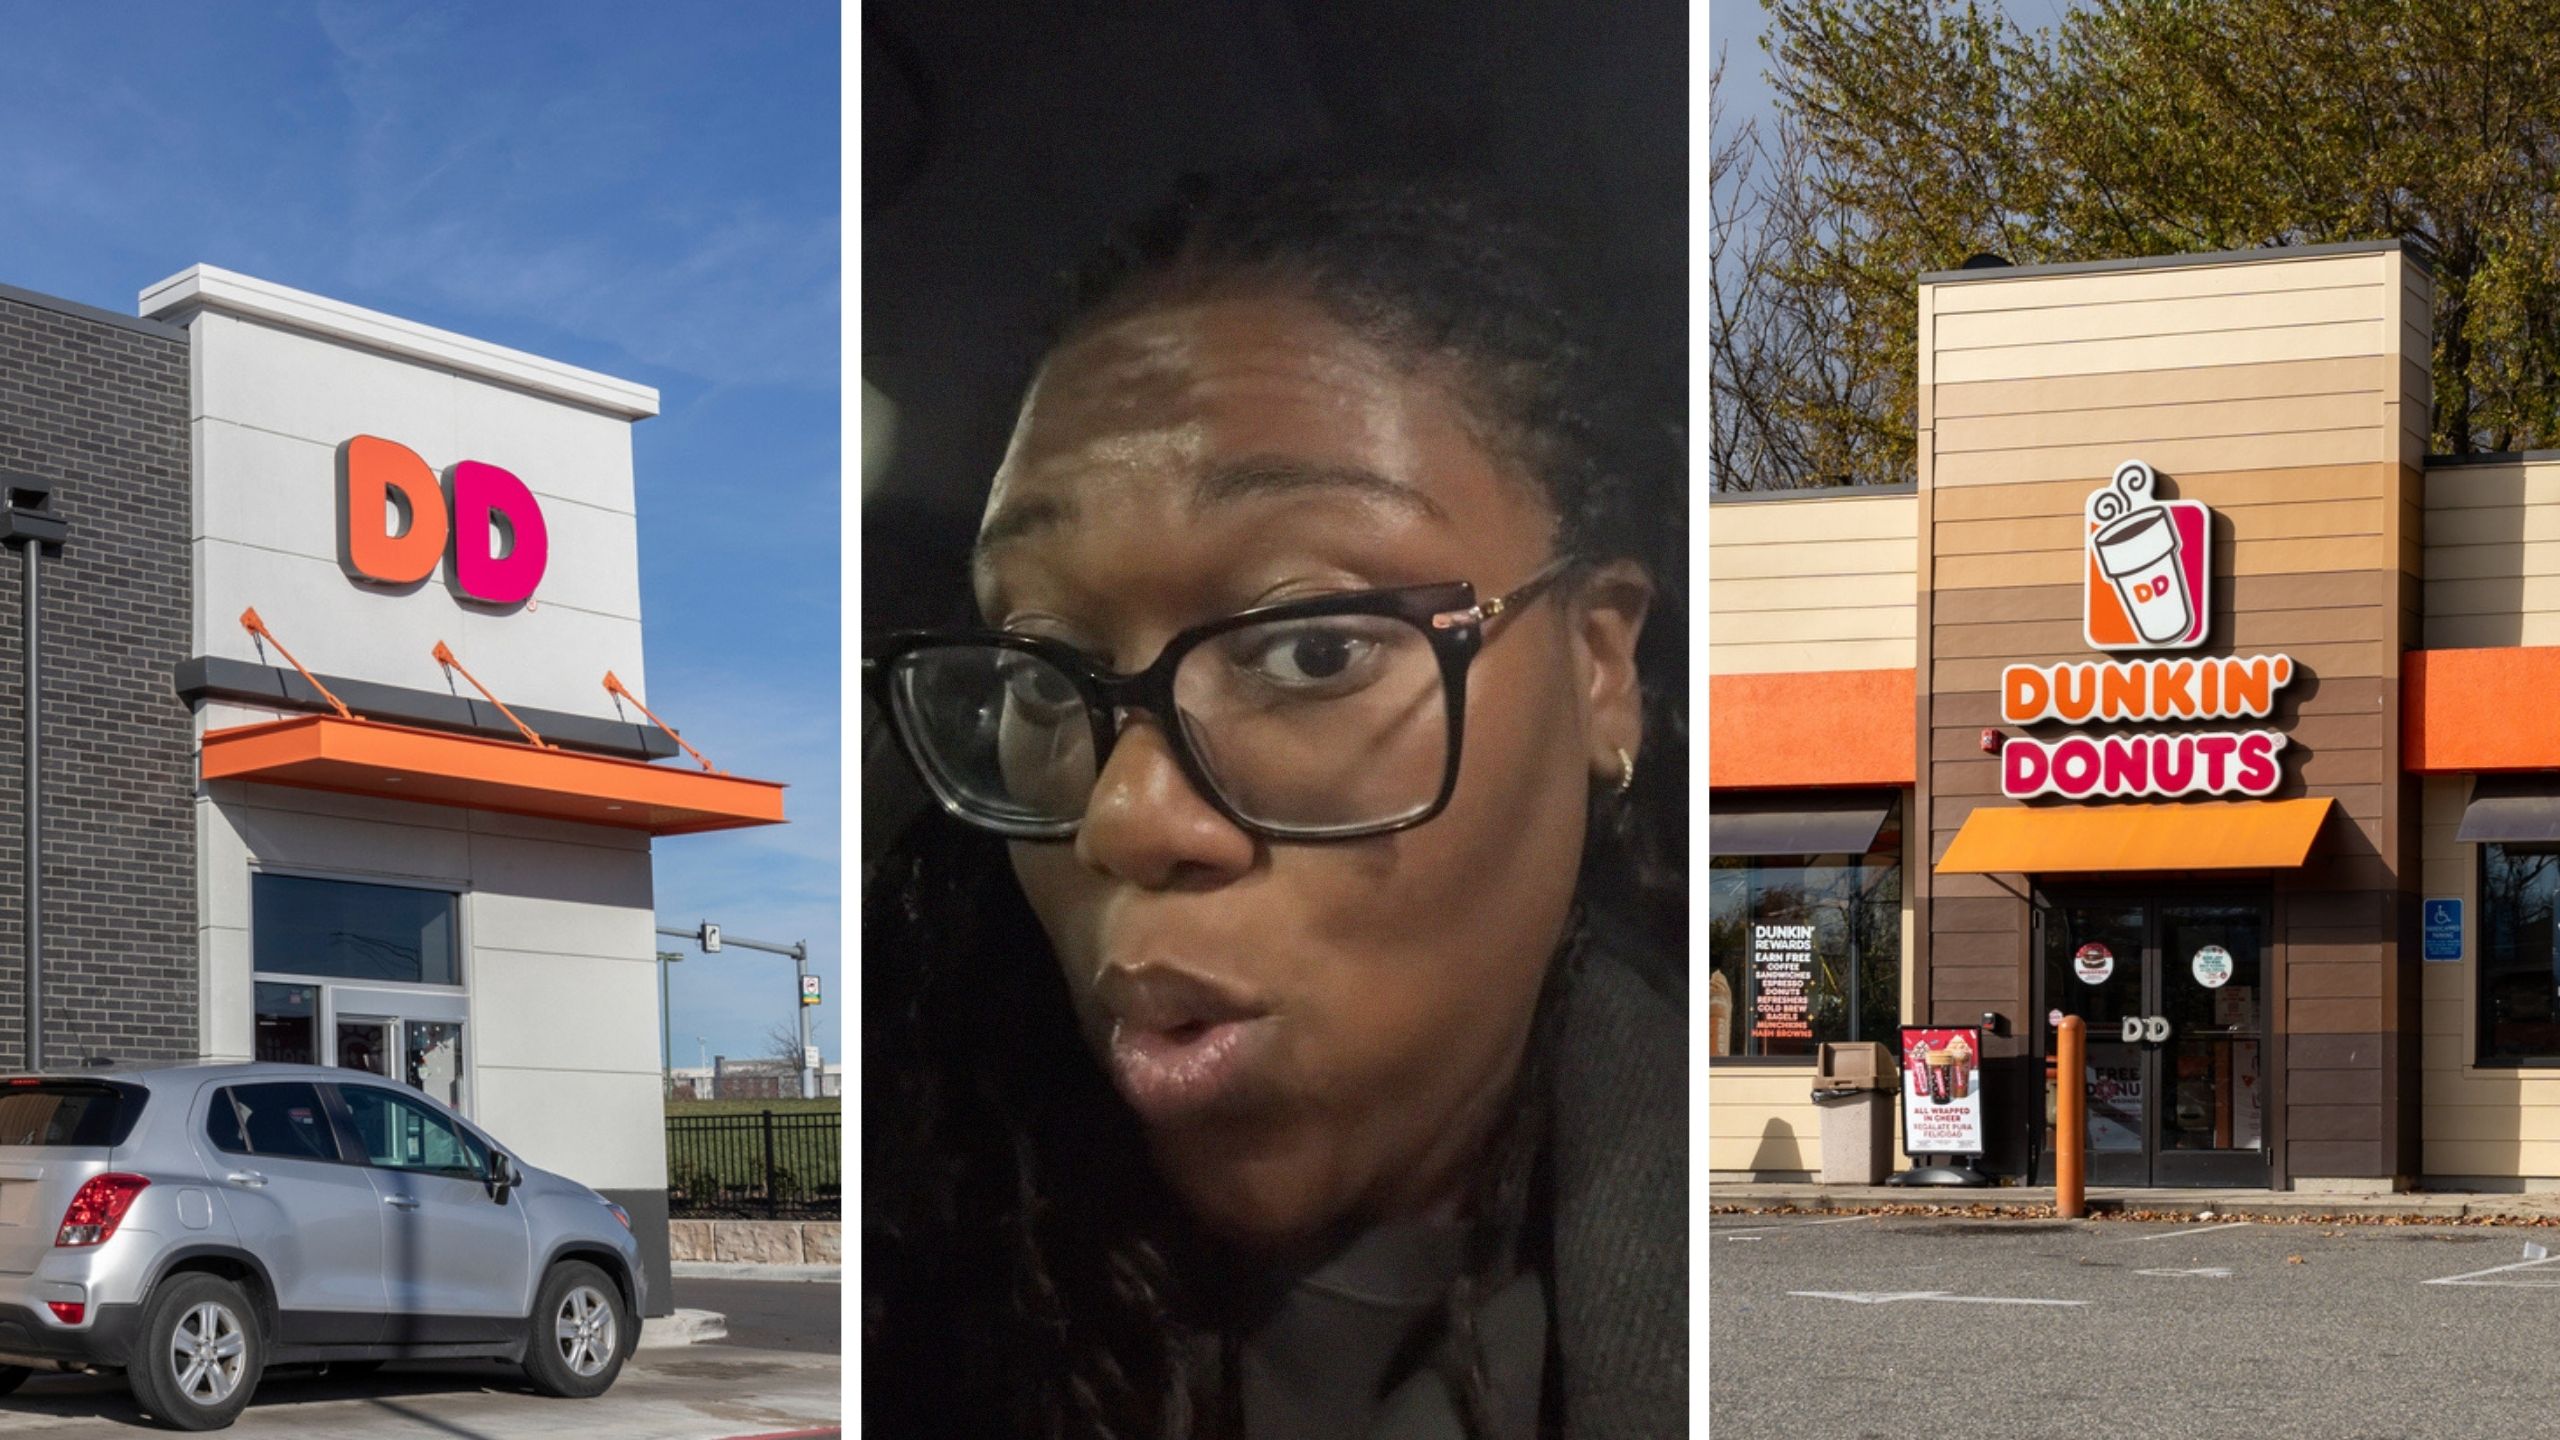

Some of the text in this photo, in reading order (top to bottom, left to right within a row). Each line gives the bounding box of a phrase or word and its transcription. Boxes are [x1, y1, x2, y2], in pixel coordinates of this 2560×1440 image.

[336, 434, 549, 603] DD
[2133, 574, 2169, 603] DD
[2004, 657, 2291, 722] DUNKIN'
[2004, 734, 2276, 795] DONUTS
[1755, 925, 1816, 939] DUNKIN'
[1755, 940, 1811, 950] REWARDS
[1755, 952, 1811, 962] EARN FREE
[1767, 963, 1800, 971] COFFEE
[1755, 971, 1811, 979] SANDWICHES
[1765, 988, 1800, 996] DONUTS
[1757, 996, 1808, 1004] REFRESHERS
[1757, 1004, 1807, 1012] COLD BREW
[1757, 1021, 1807, 1029] MUNCHKINS
[2122, 1015, 2170, 1042] DD
[1751, 1029, 1813, 1037] HASH BROWNS
[2095, 1067, 2140, 1081] FREE
